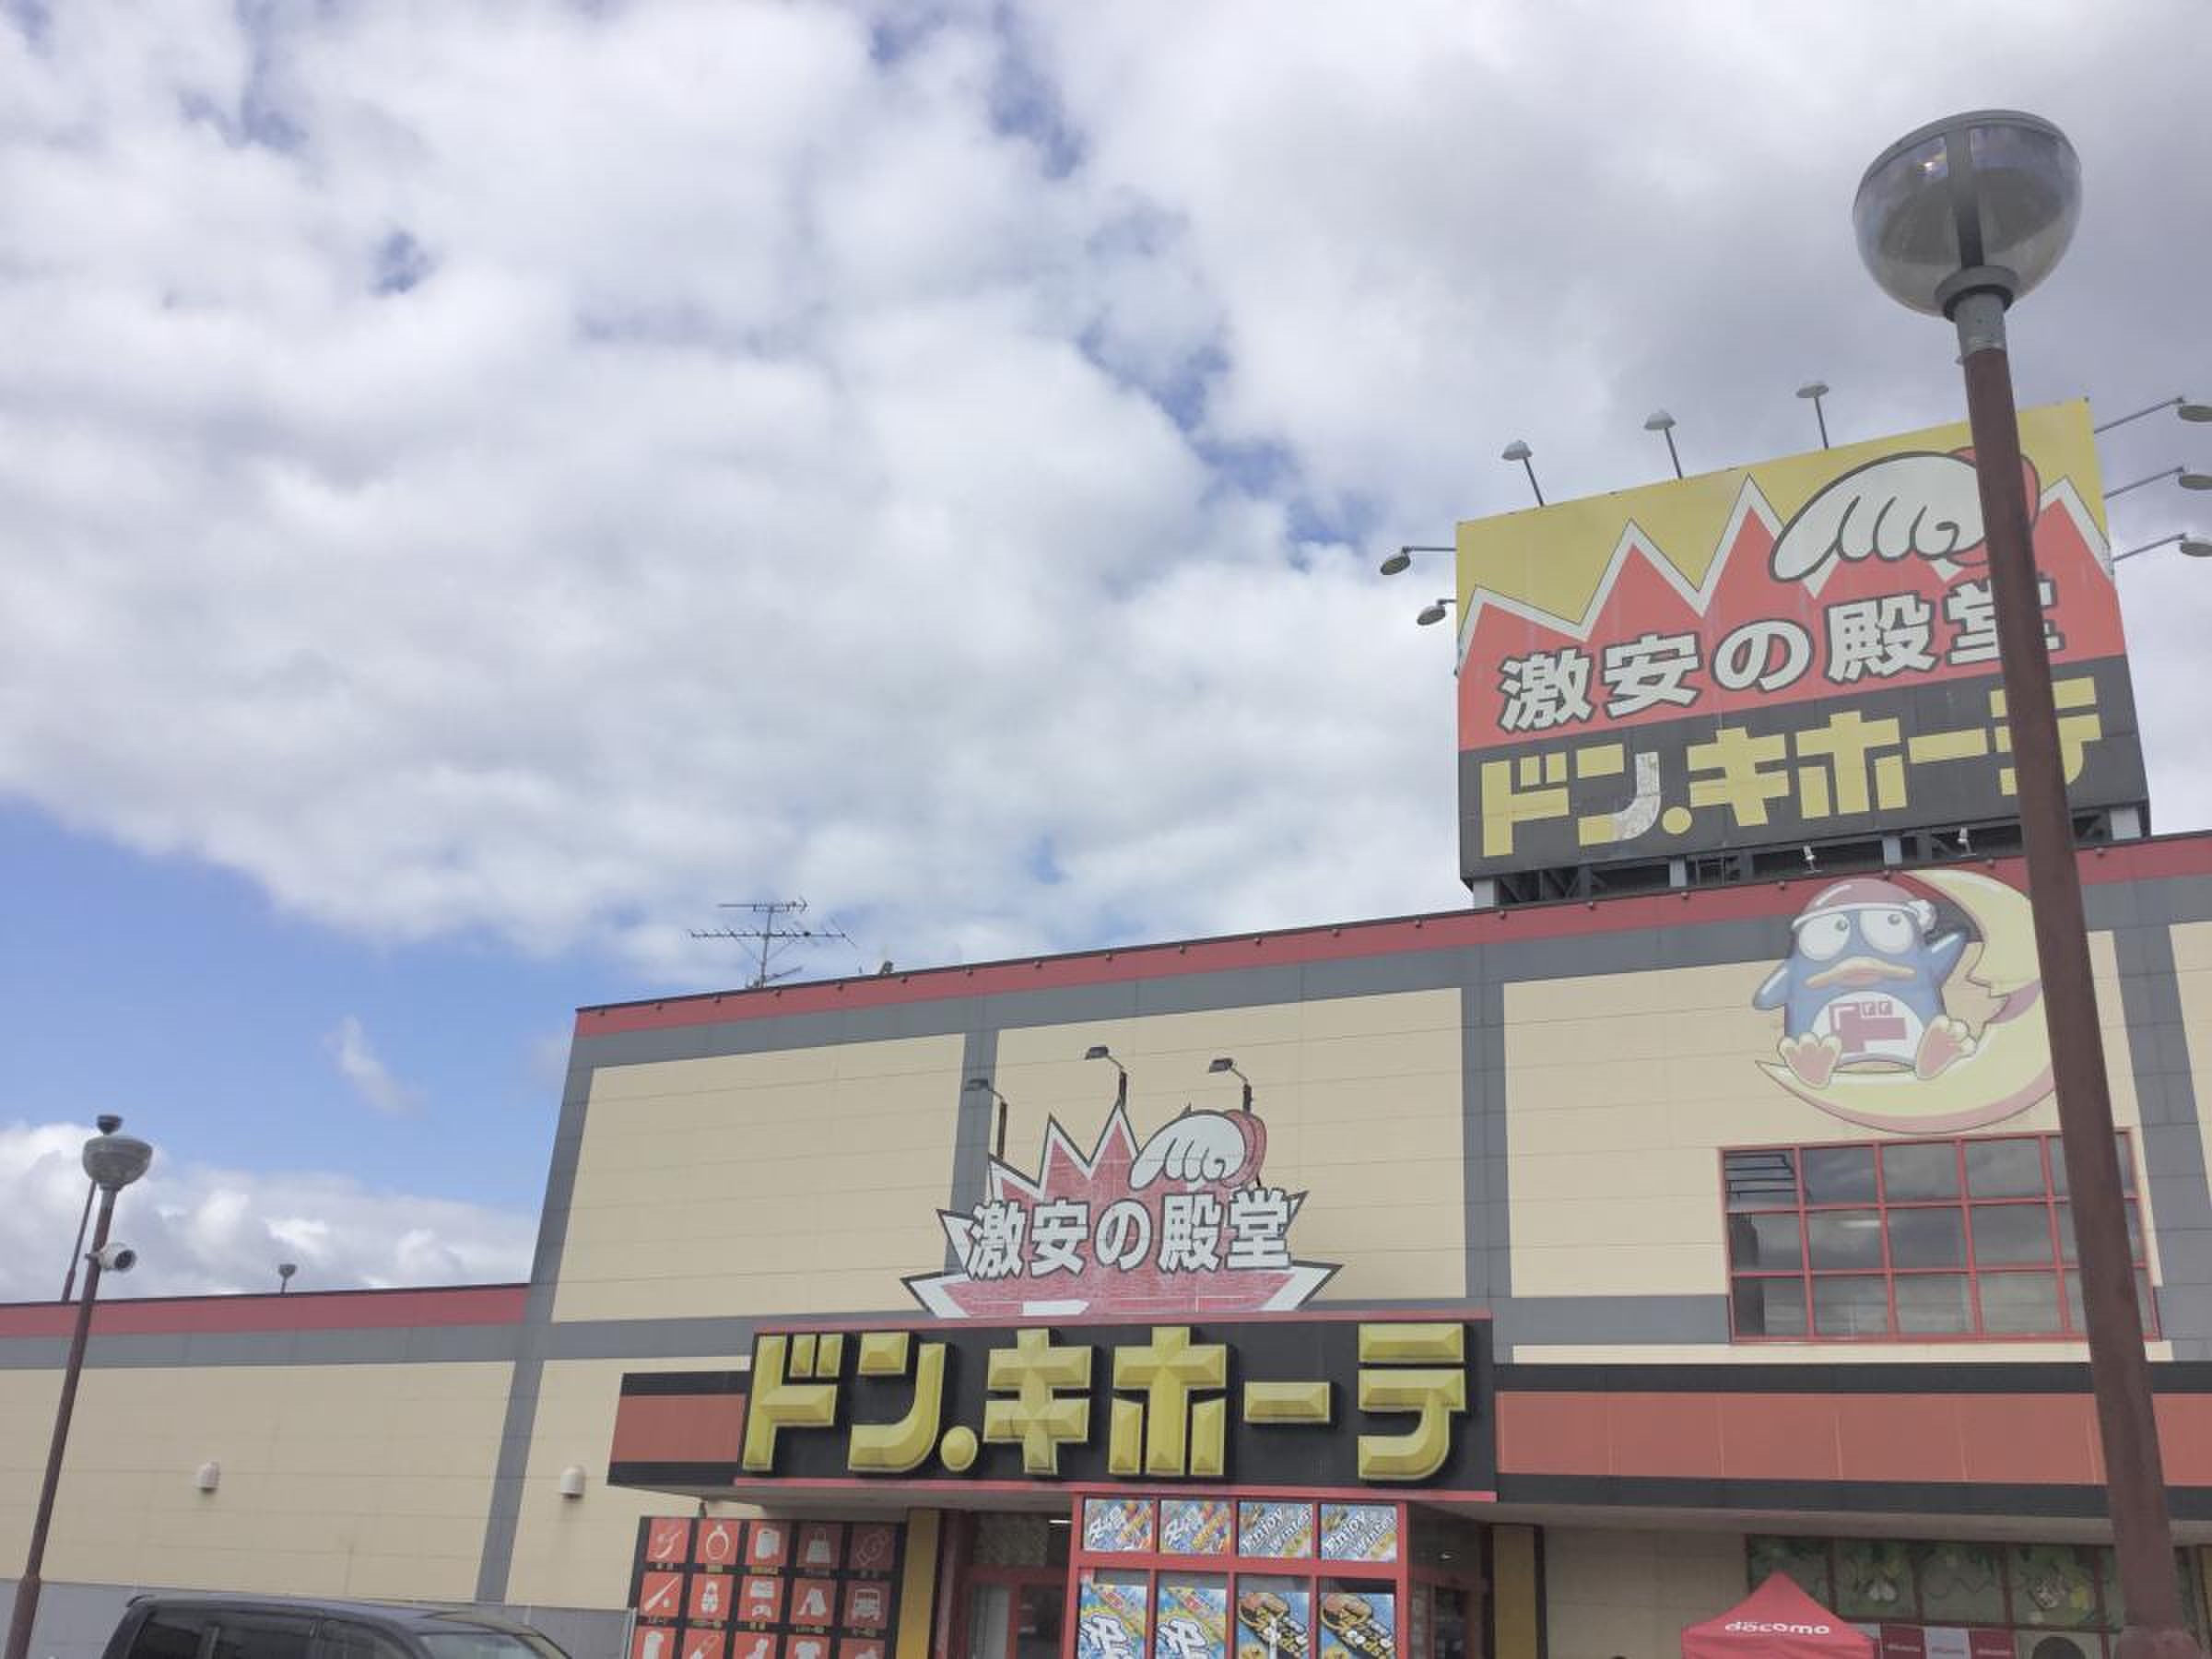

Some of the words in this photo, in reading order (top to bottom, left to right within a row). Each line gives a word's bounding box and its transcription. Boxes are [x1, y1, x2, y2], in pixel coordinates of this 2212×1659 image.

[962, 1188, 1293, 1279] 激安の殿堂
